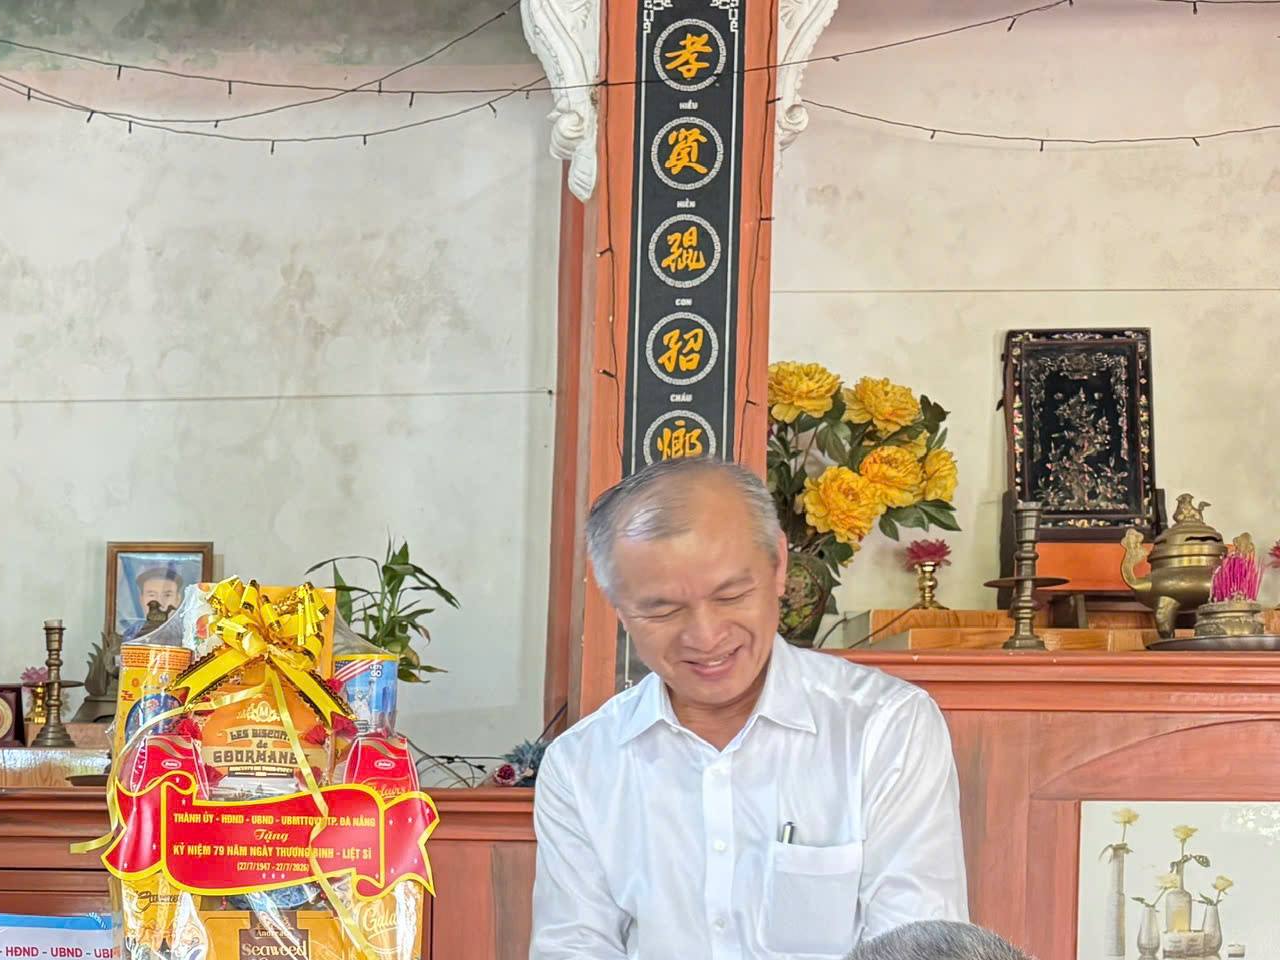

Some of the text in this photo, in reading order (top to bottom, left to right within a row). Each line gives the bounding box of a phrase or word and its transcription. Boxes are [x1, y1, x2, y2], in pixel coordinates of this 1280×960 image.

[230, 729, 249, 741] LES
[256, 740, 268, 749] de
[174, 812, 201, 823] THÀNH
[203, 811, 214, 823] ỦY
[251, 815, 274, 825] UBND
[255, 828, 289, 843] Tặng
[188, 843, 211, 858] NIỆM
[213, 845, 224, 855] 79
[227, 844, 247, 856] NĂM
[250, 844, 273, 857] NGÀY
[342, 847, 361, 861] LIỆT
[5, 946, 39, 957] HĐND
[50, 947, 82, 958] UBND
[241, 940, 307, 956] Seaweed
